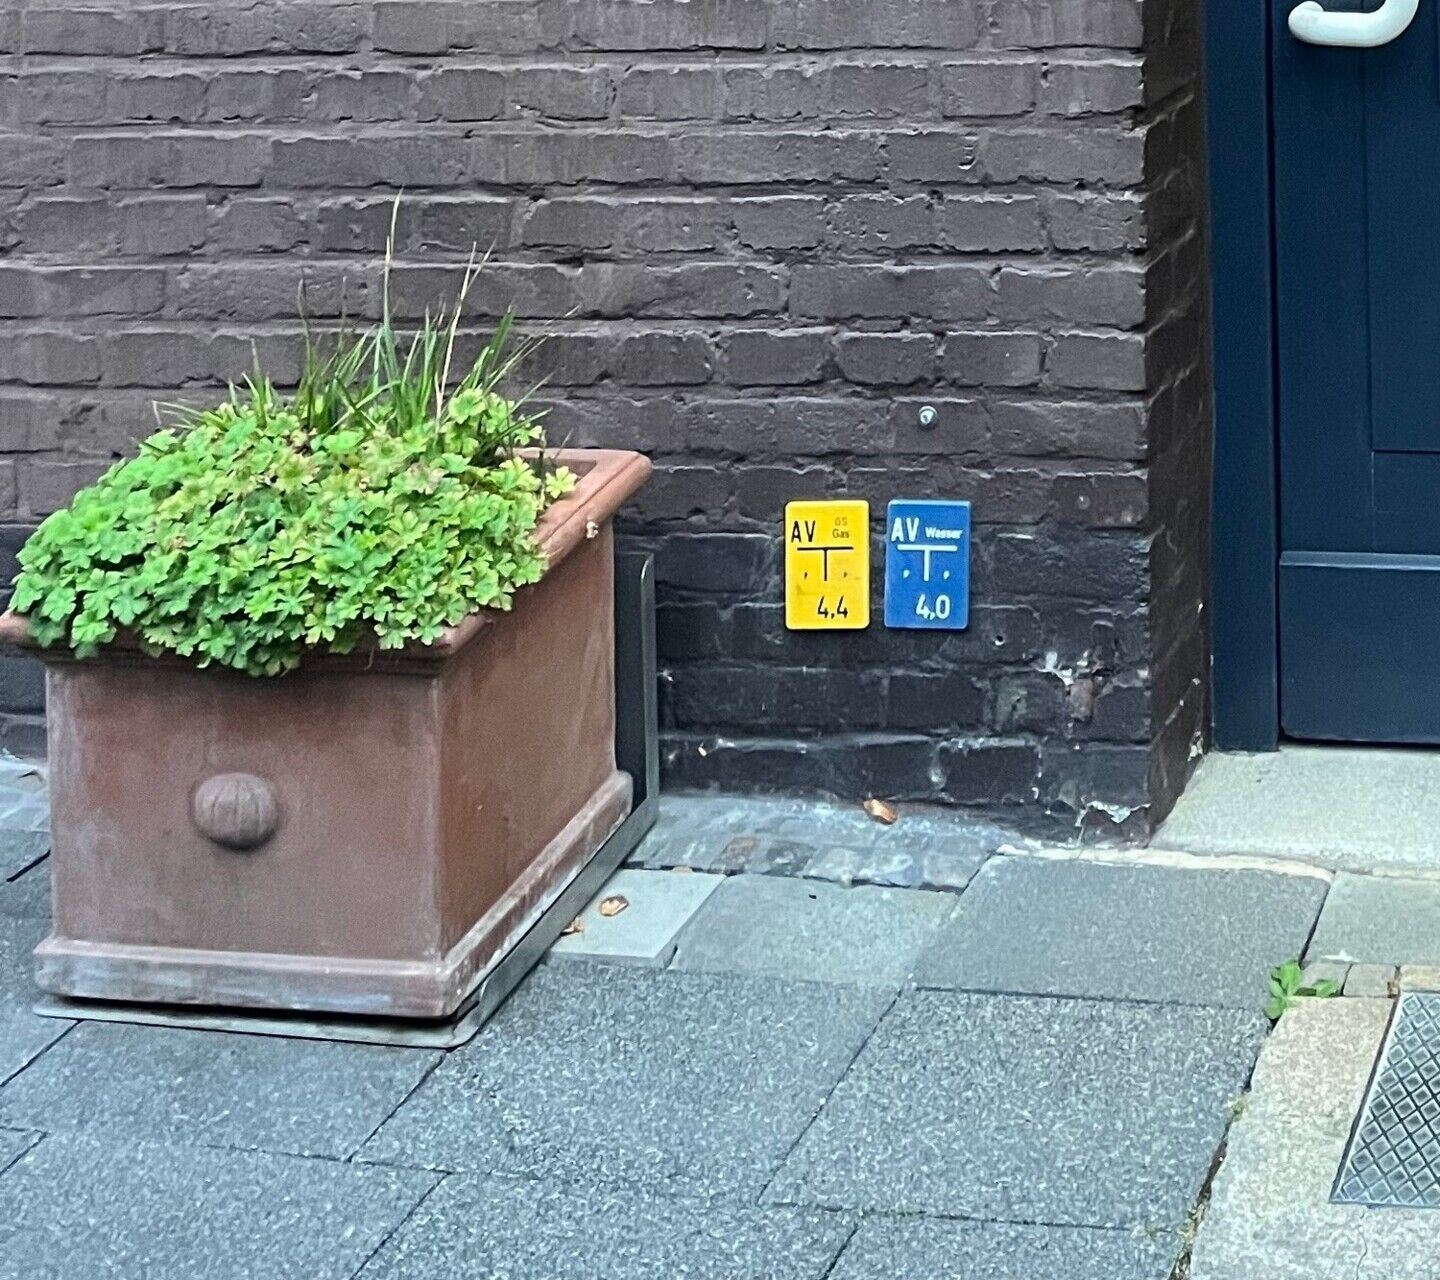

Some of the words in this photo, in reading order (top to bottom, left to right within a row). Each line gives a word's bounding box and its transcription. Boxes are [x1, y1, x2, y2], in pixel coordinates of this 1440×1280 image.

[791, 520, 816, 543] AV
[832, 528, 850, 539] Gas
[891, 517, 920, 542] AV
[925, 527, 963, 539] Wasser
[817, 595, 848, 619] 4,4
[915, 594, 951, 620] 4,0
